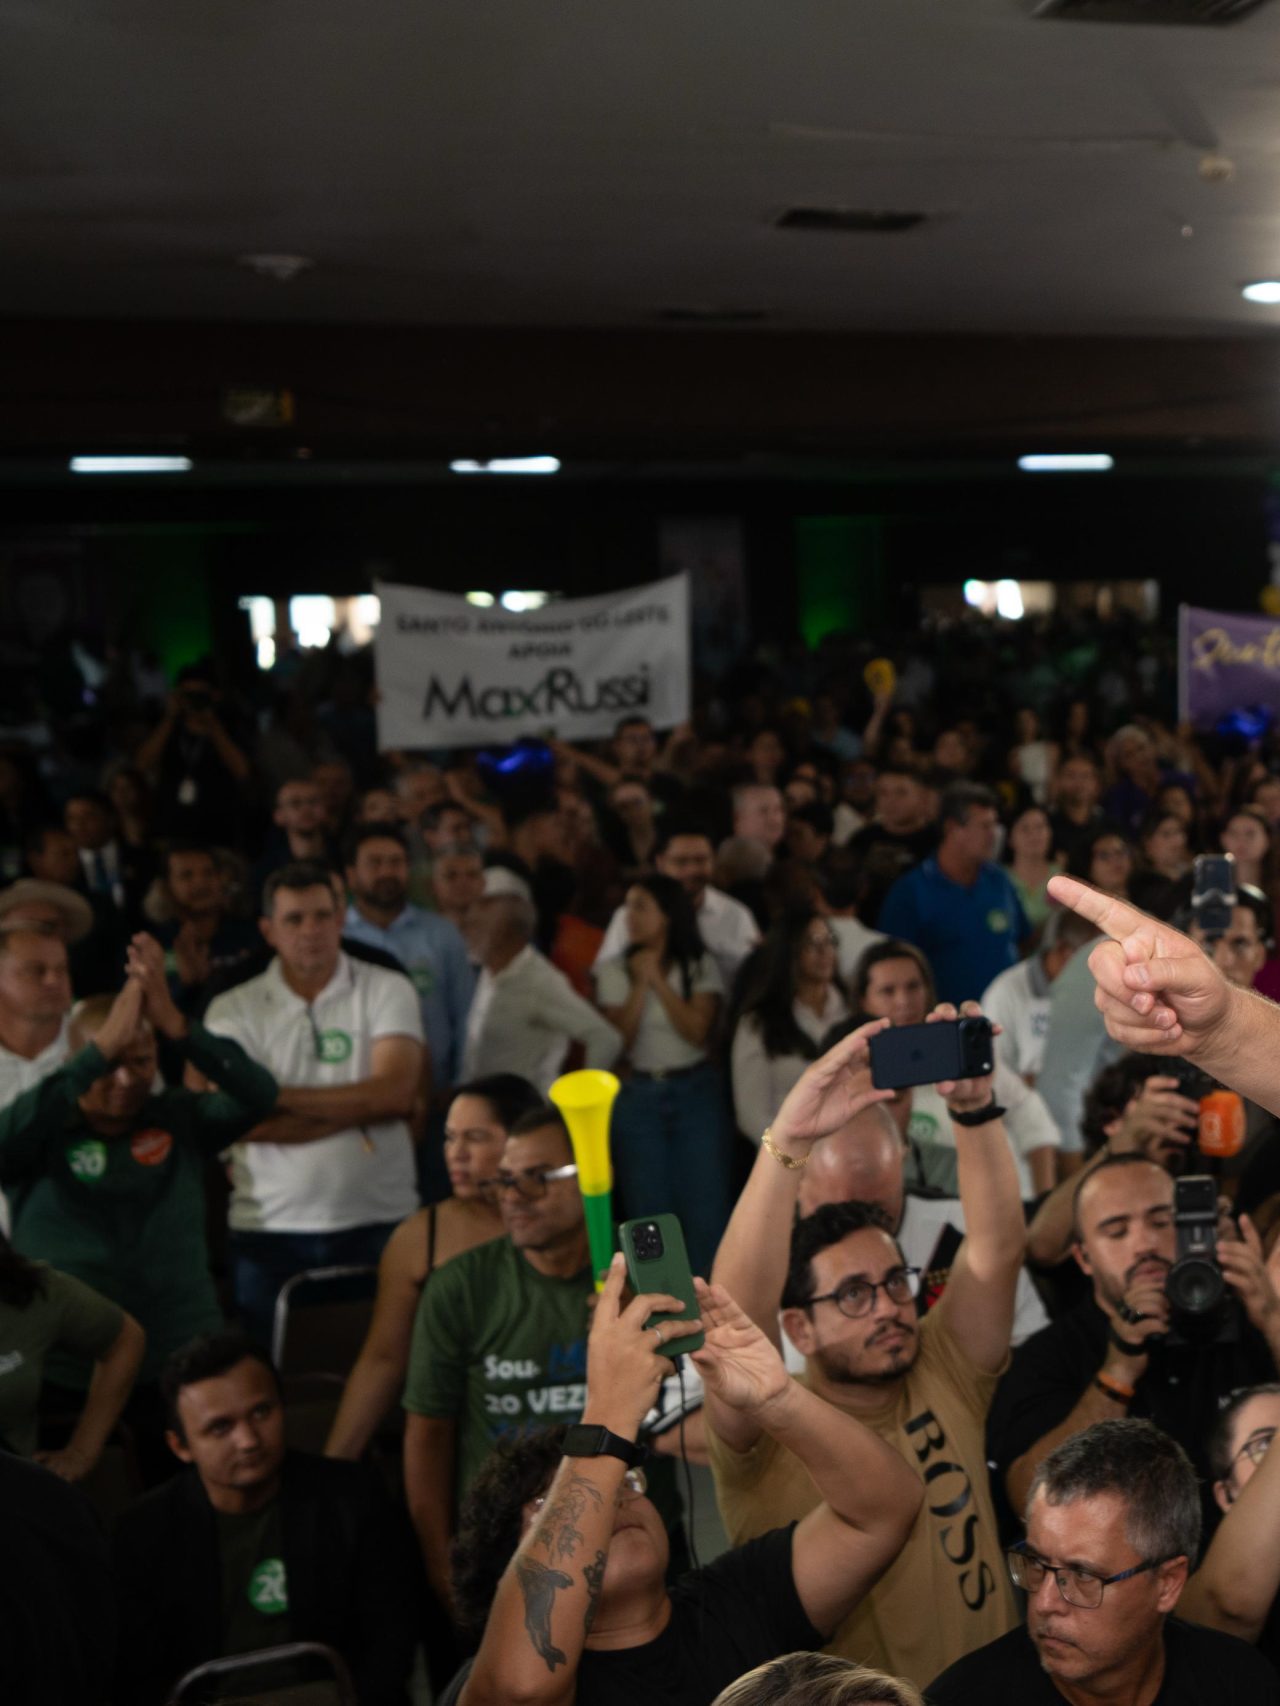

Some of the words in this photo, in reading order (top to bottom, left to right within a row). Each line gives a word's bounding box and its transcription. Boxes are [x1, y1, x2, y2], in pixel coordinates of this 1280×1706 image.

[483, 1394, 523, 1416] 20
[525, 1382, 589, 1415] VEZ
[904, 1408, 996, 1612] BOSS
